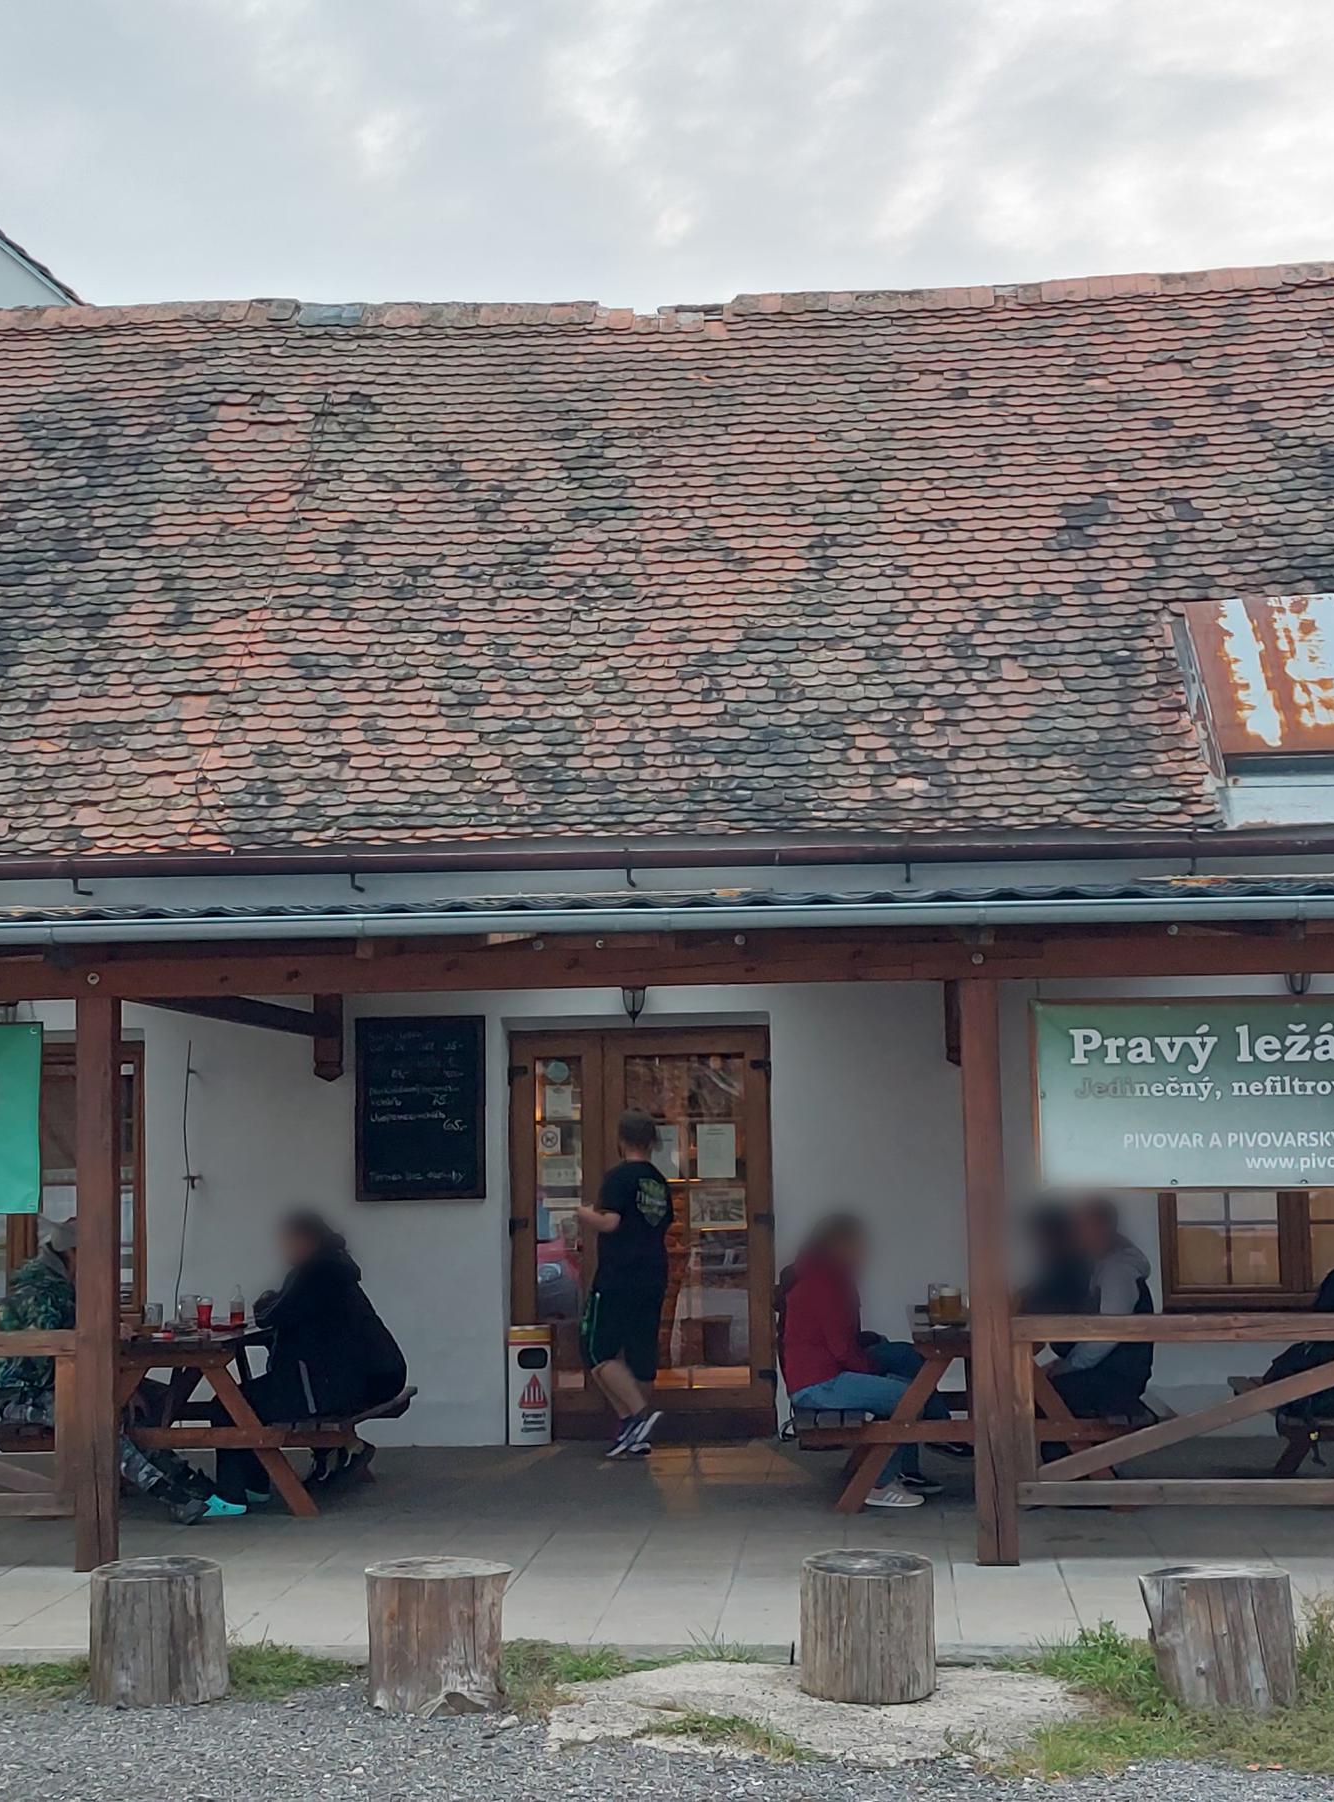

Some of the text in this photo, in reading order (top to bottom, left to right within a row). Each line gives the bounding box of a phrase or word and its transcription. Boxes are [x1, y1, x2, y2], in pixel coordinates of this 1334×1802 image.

[1068, 1024, 1218, 1074] Pravý
[1074, 1076, 1222, 1102] Jedinečný,
[1123, 1132, 1205, 1149] PIVOVAR
[1209, 1132, 1224, 1149] A
